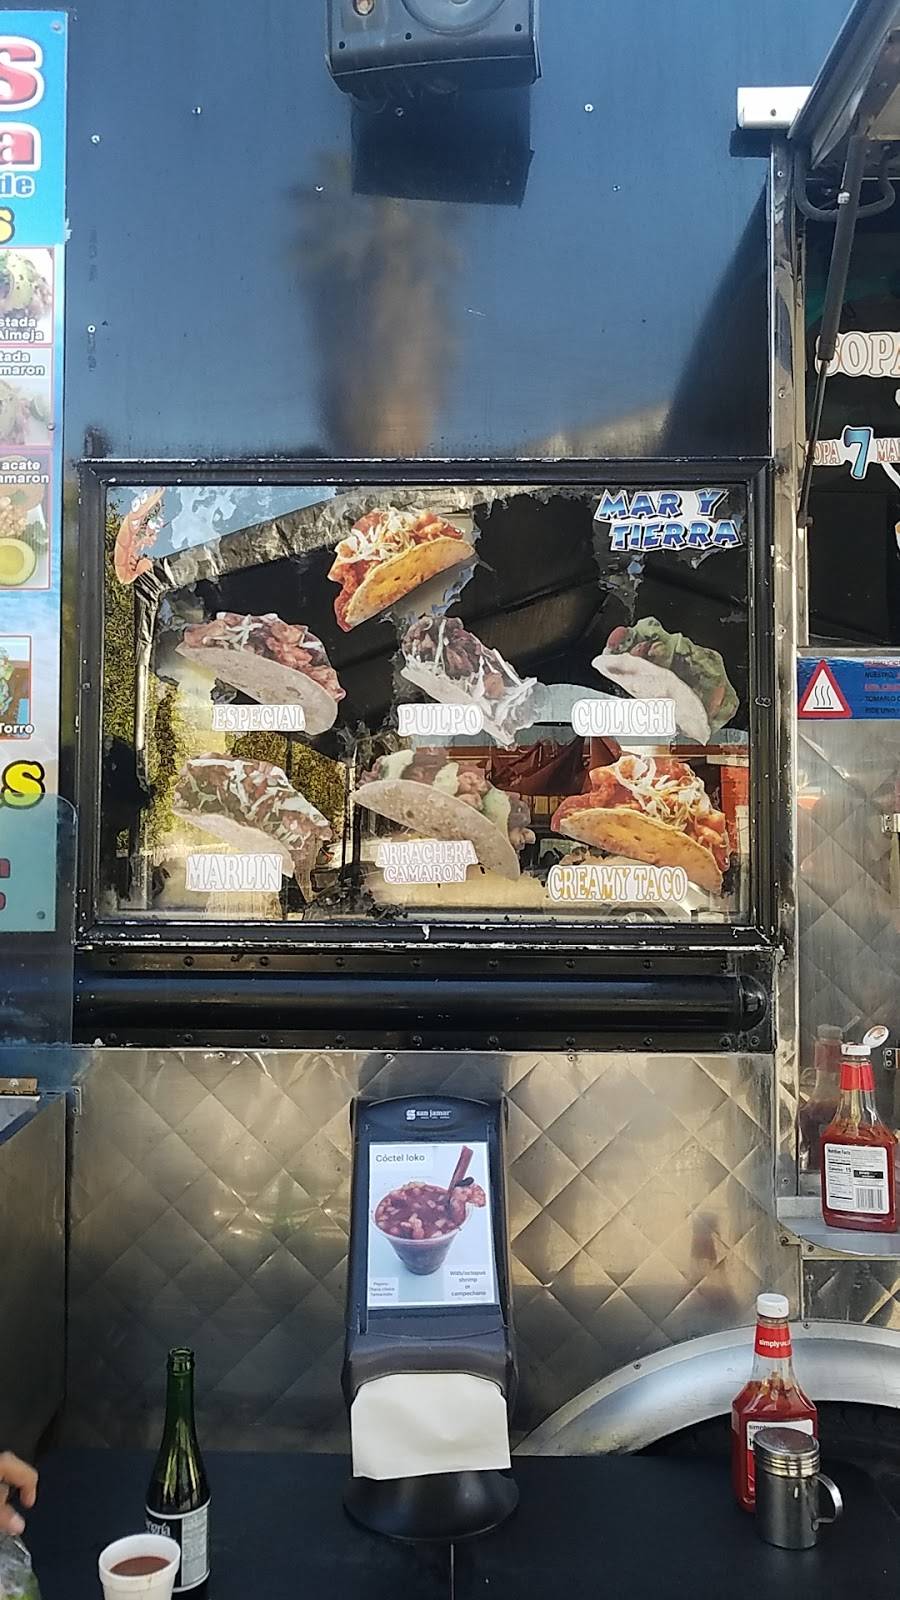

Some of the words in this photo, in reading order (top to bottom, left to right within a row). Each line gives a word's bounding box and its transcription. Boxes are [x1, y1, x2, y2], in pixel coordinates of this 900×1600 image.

[806, 441, 841, 465] OPA
[844, 427, 872, 479] 7
[594, 488, 683, 520] MAR
[695, 488, 729, 519] Y
[609, 519, 744, 552] TIERRA
[213, 705, 305, 731] ESPECIAL
[398, 704, 483, 735] PULPO
[573, 700, 676, 735] CULICHI
[377, 841, 478, 865] ARRACHERA
[186, 854, 282, 891] MARLIN
[384, 864, 467, 883] CAMARON
[549, 866, 631, 901] CREAMY
[634, 866, 685, 901] TACO
[376, 1153, 404, 1162] Cóctel
[406, 1153, 425, 1162] loko
